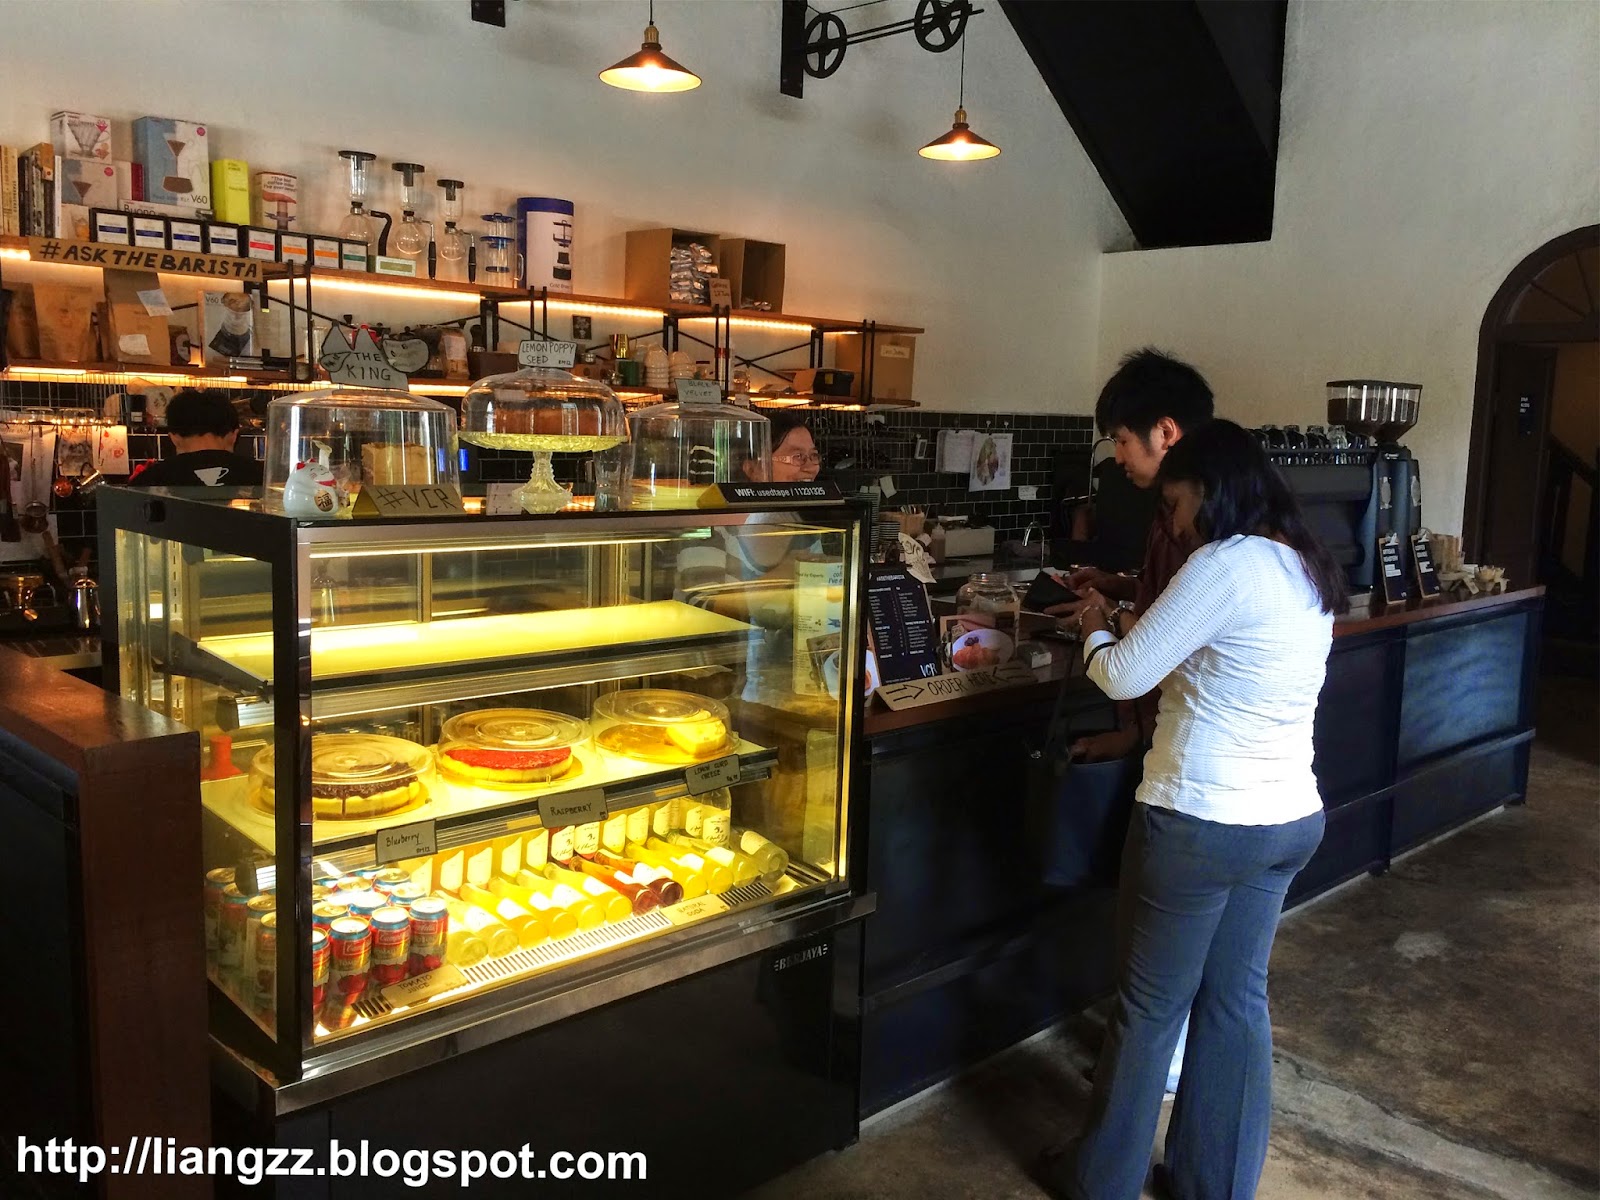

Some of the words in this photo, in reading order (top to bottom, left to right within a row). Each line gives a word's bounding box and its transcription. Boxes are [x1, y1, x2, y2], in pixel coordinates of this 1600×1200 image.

[191, 194, 208, 205] V60
[521, 342, 548, 353] LEMON
[549, 341, 575, 354] POPPY
[353, 352, 381, 362] THE
[526, 354, 549, 365] SEED
[346, 363, 391, 381] KING
[376, 488, 457, 510] #VCR
[757, 487, 790, 498] usedtape
[318, 492, 333, 509] 福
[927, 677, 968, 696] ORDER
[550, 802, 592, 816] RASPBERRY
[385, 832, 423, 848] Blueberry
[397, 974, 433, 990] TOMATO
[407, 981, 430, 994] JUICE
